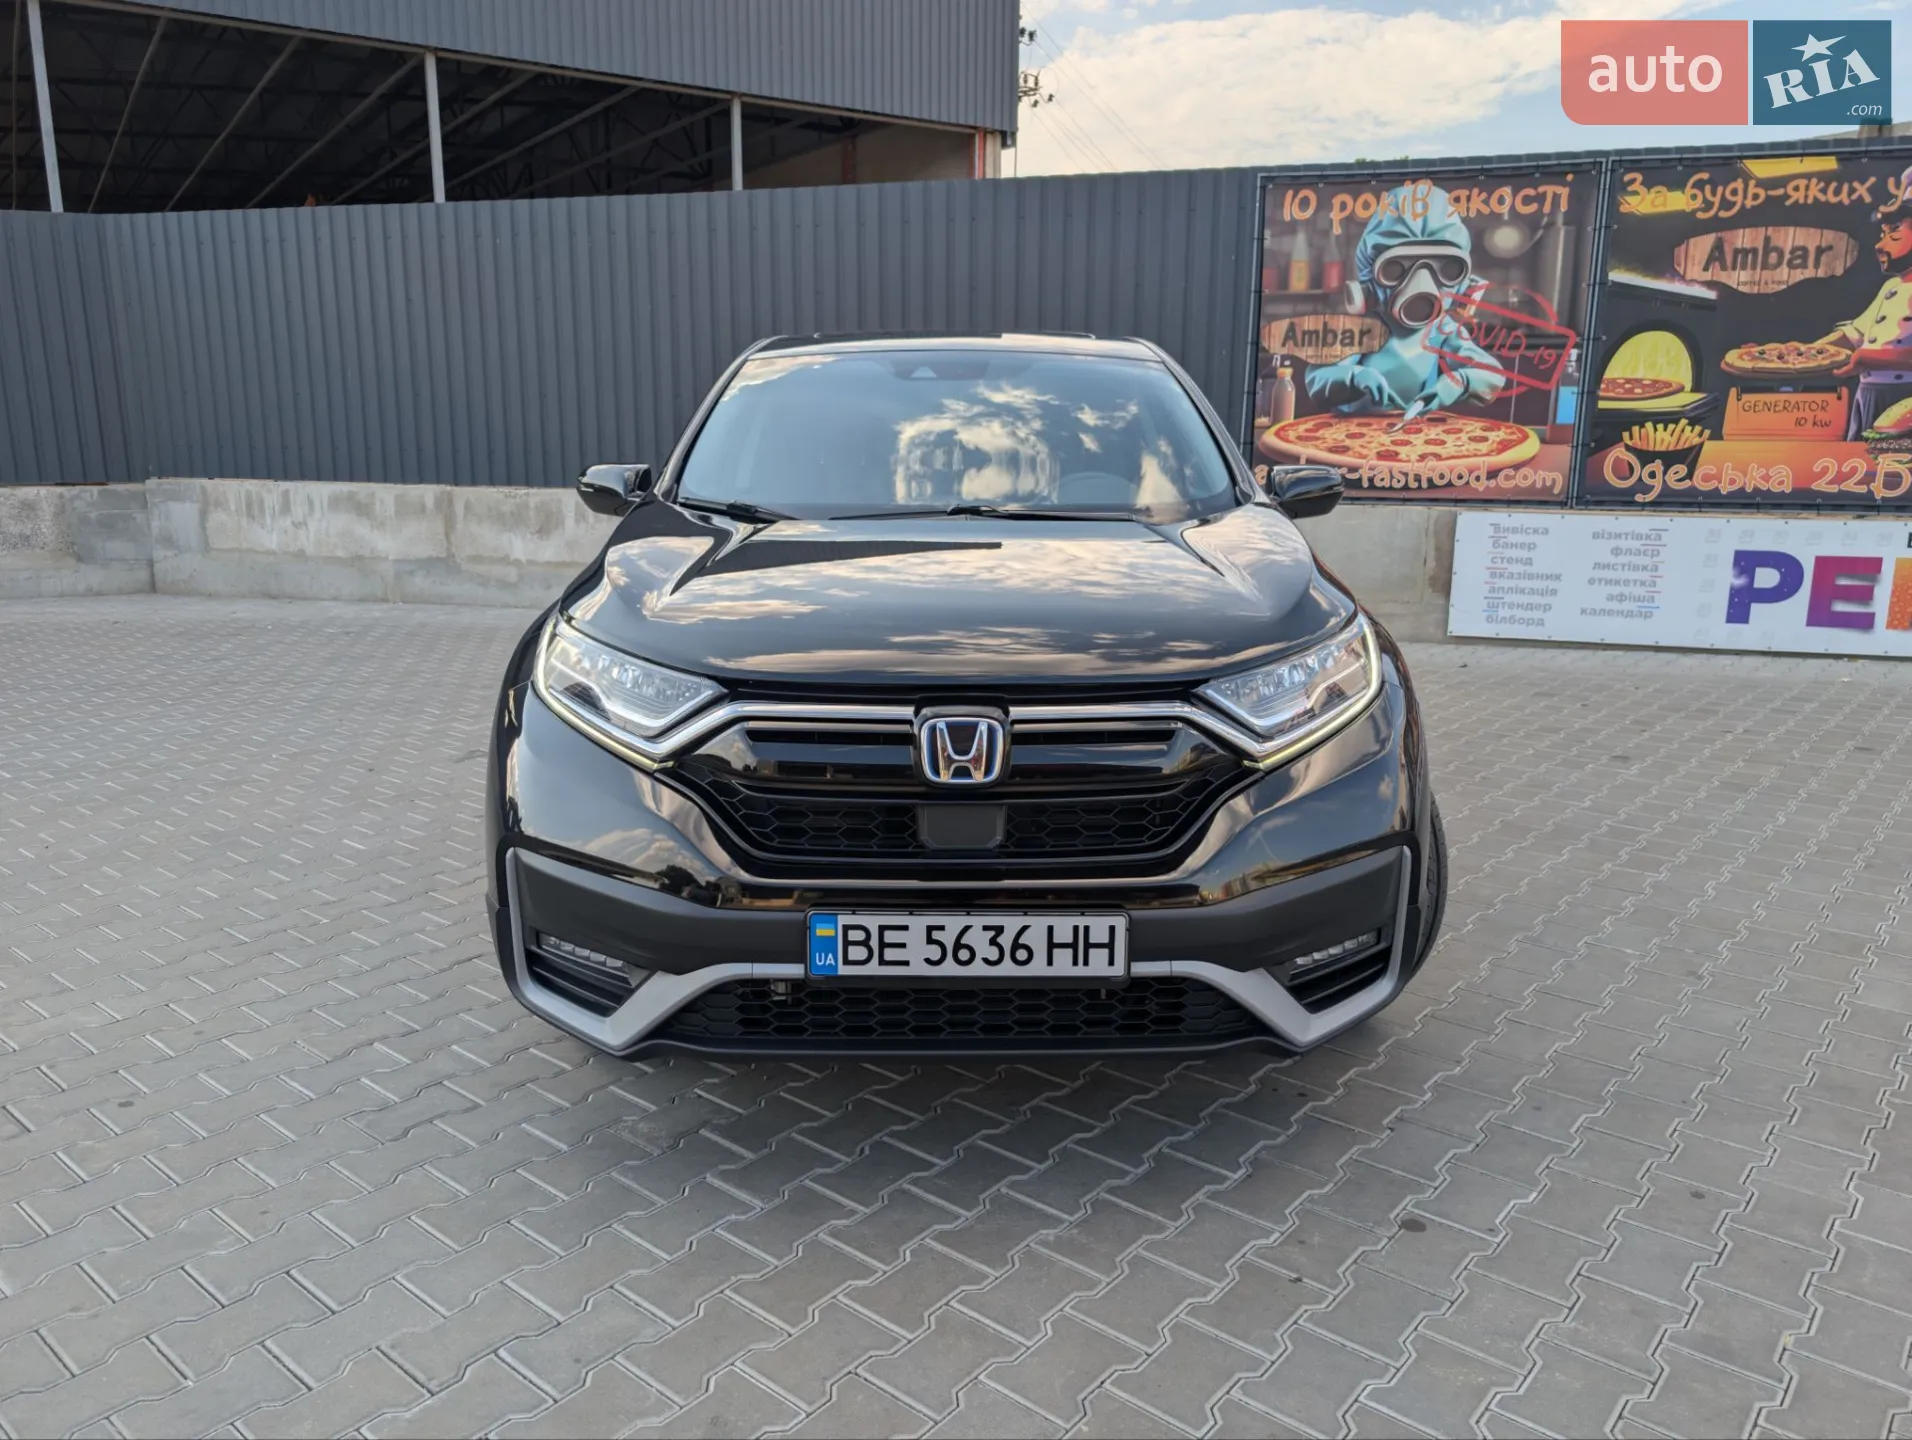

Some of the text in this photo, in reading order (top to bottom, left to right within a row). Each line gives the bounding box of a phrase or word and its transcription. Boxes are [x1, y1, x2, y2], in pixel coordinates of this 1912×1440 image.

[1619, 173, 1667, 213] За
[1685, 173, 1876, 219] будь-яких
[1331, 179, 1432, 235] років
[1447, 174, 1574, 219] якості
[1702, 234, 1834, 272] Ambar
[1281, 321, 1372, 348] Ambar
[1437, 310, 1556, 371] COVID-19
[1742, 399, 1828, 414] GENERATOR
[1795, 416, 1807, 428] 10
[1603, 448, 1912, 502] Одеська 22Б
[1592, 529, 1662, 542] візитівка
[1492, 539, 1537, 552] банер
[1490, 556, 1533, 566] стенд
[1592, 561, 1658, 573] листівка
[1489, 570, 1563, 582] вказівник
[1587, 576, 1657, 588] етикетка
[1488, 585, 1558, 597] аплікація
[1605, 592, 1655, 604] афіша
[1486, 600, 1553, 613] штендер
[1485, 613, 1545, 627] білборд
[1580, 607, 1654, 620] календар
[841, 924, 1115, 967] BE 5636 HH
[815, 953, 836, 966] UA
